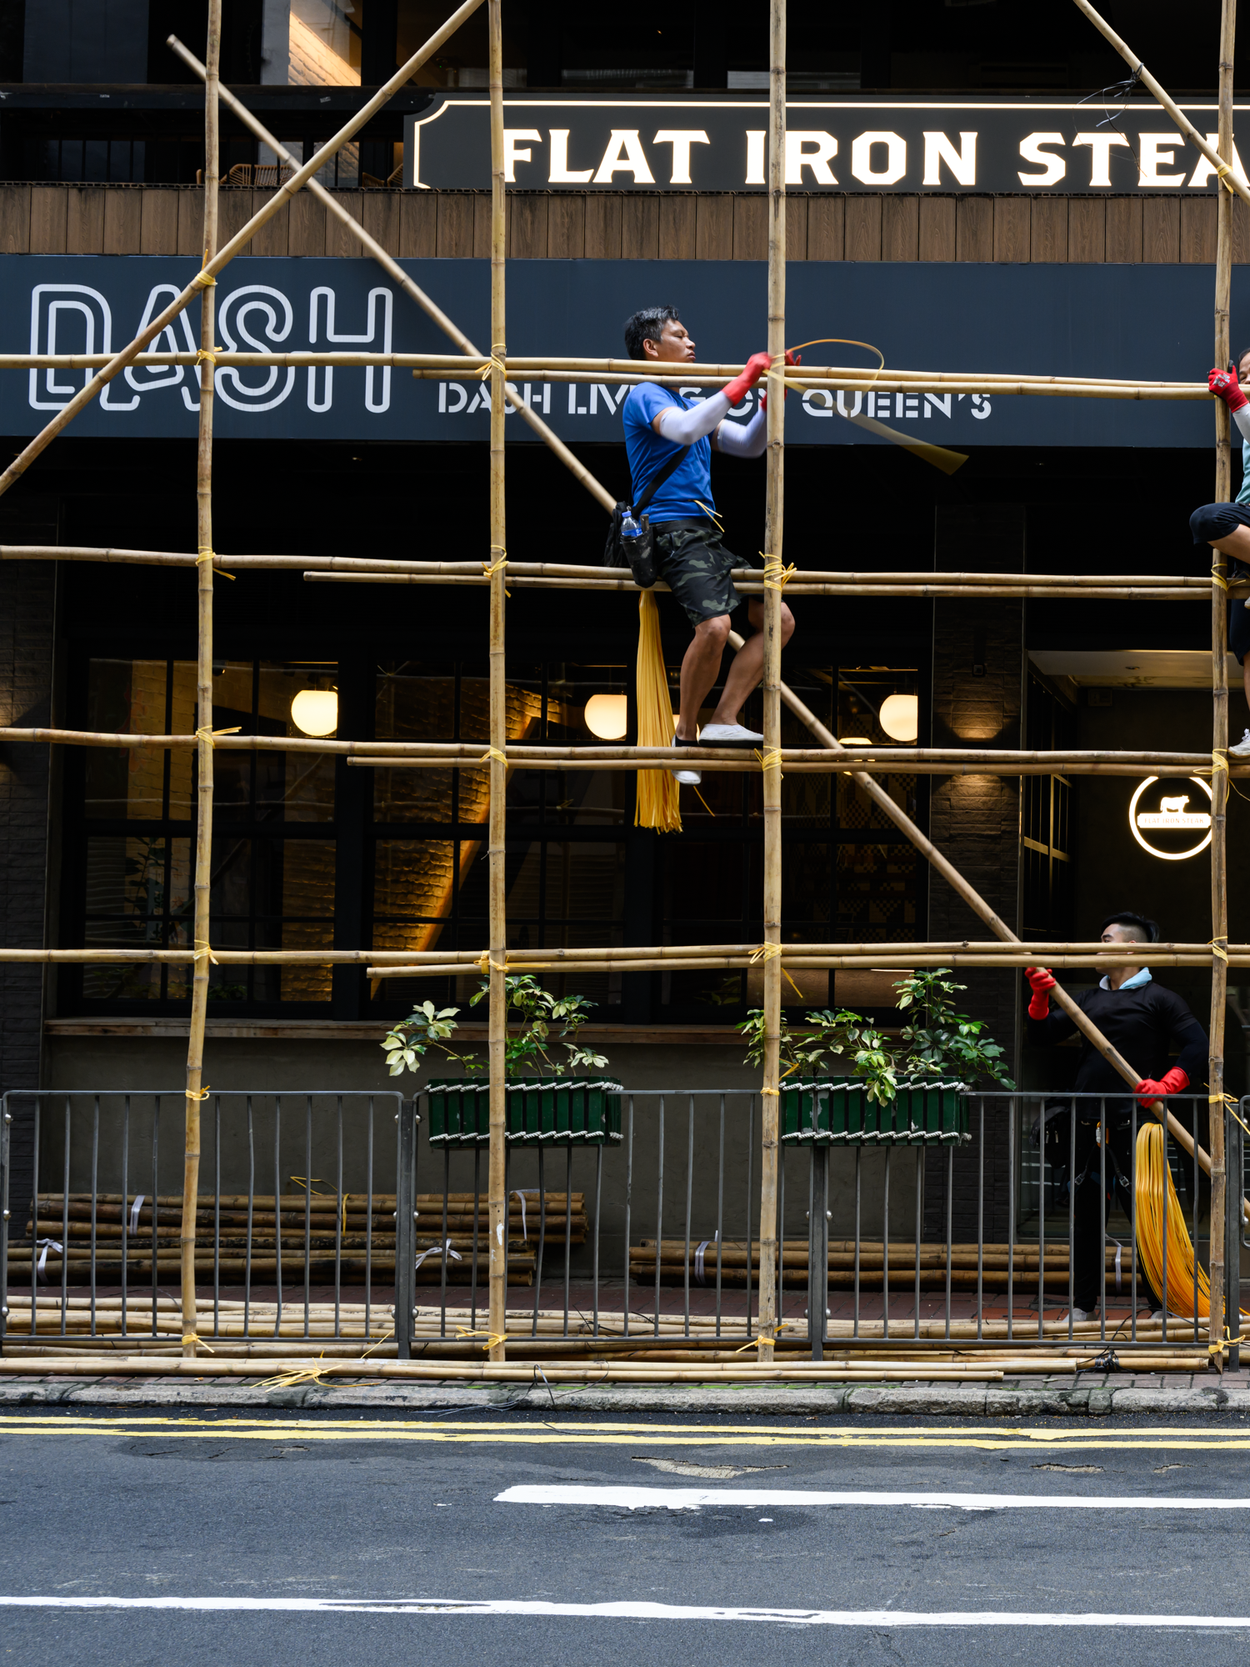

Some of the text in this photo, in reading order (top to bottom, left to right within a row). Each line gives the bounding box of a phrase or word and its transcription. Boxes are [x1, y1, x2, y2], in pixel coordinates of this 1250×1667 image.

[503, 128, 710, 184] FLAT
[745, 130, 978, 186] IRON
[29, 284, 394, 414] DASH
[801, 388, 993, 420] QUEEN'S
